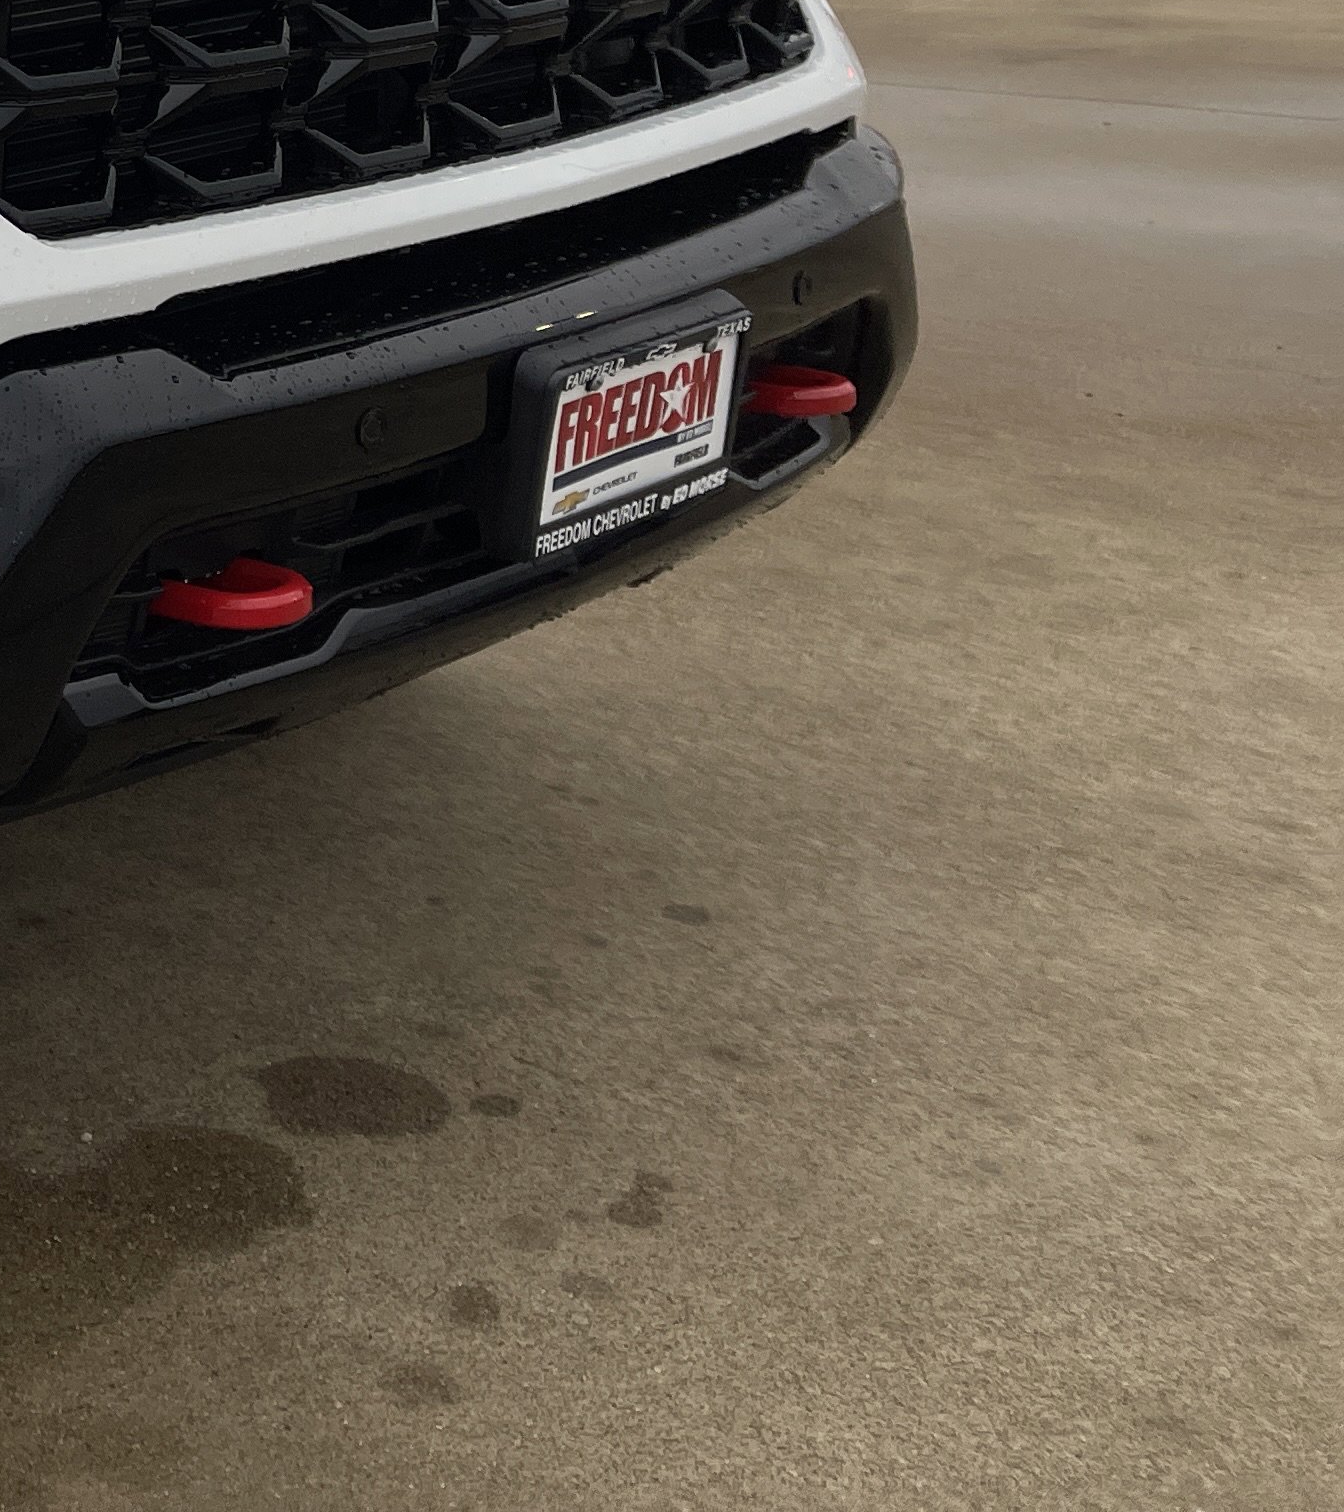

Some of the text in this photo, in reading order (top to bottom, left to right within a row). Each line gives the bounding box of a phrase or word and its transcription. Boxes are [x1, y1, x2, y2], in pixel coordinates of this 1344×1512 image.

[717, 317, 752, 338] TEXAS
[566, 357, 625, 391] FAIRFIELD
[554, 349, 723, 474] FREEDOM
[593, 472, 638, 496] CHEVROLET
[535, 518, 592, 558] FREEDOM
[593, 493, 659, 536] CHEVROLET
[672, 484, 688, 505] ED
[688, 468, 729, 499] MORSE
